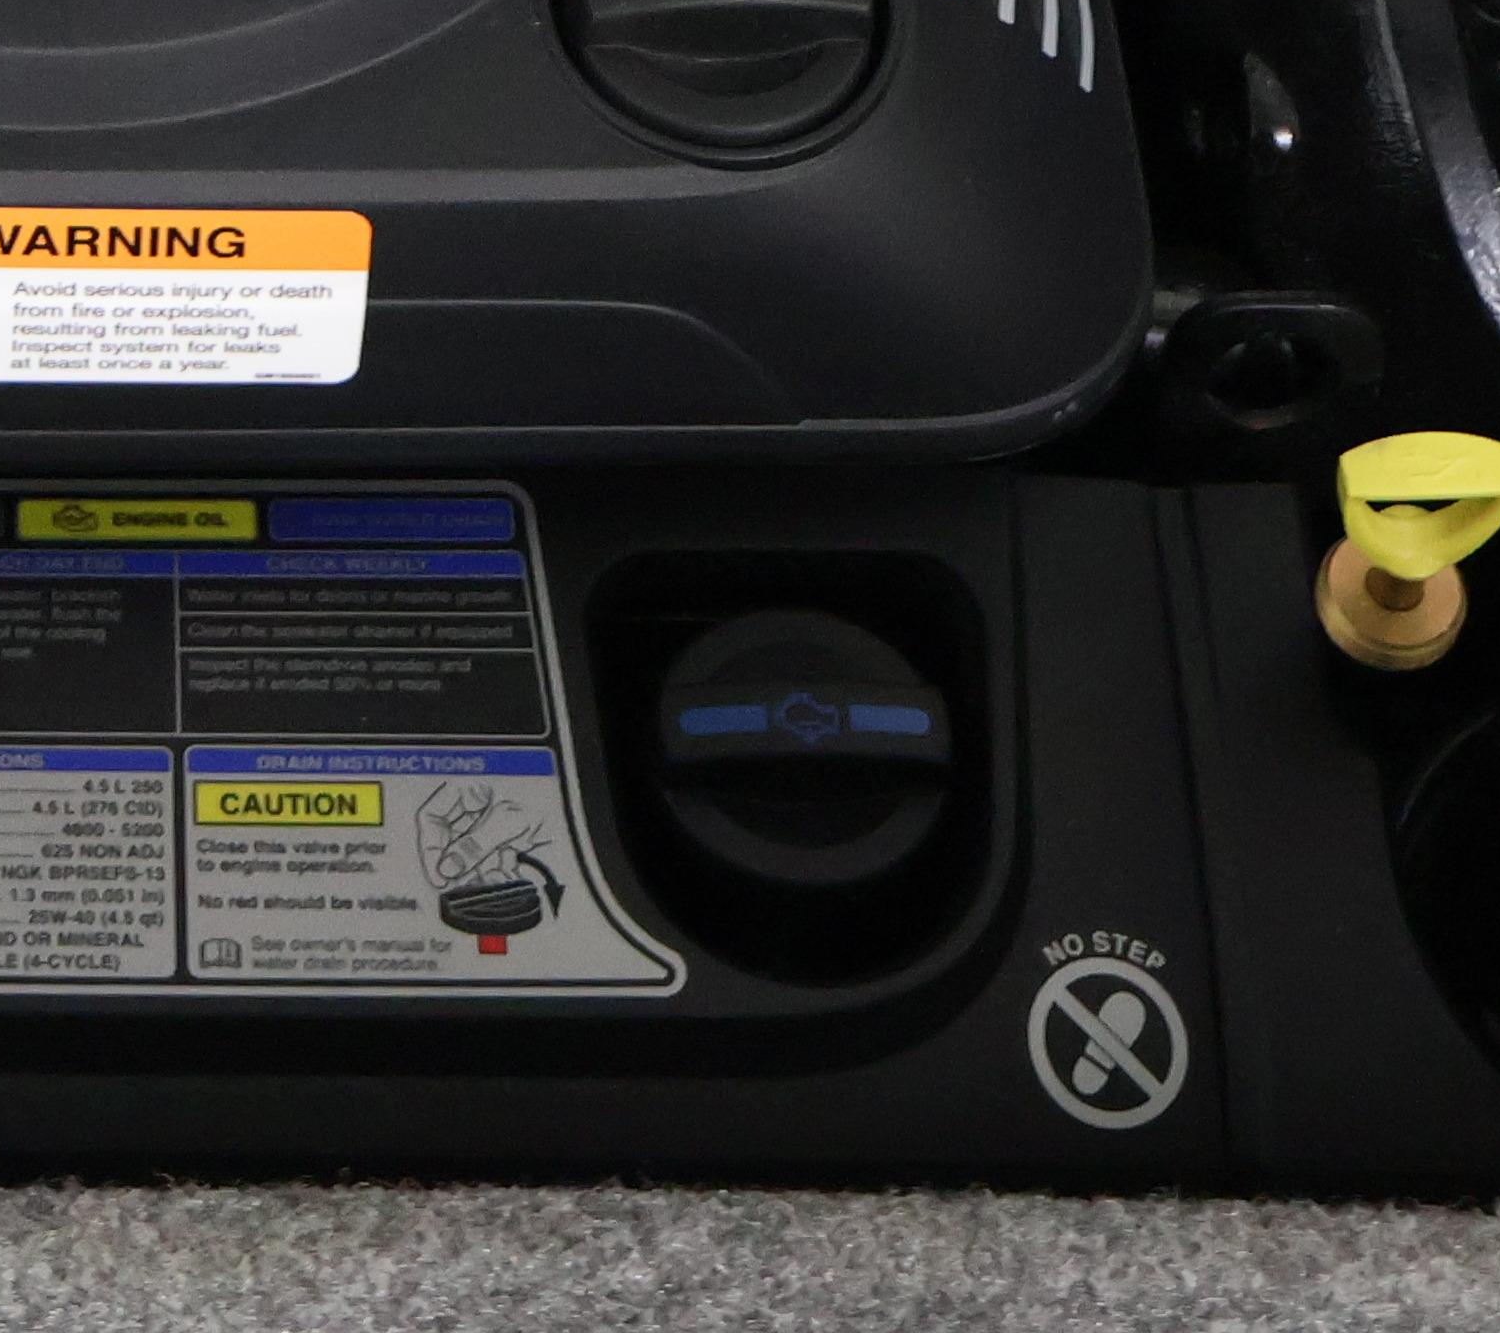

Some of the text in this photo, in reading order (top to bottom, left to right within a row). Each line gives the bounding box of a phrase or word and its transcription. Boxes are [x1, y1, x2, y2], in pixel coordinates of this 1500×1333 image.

[13, 282, 332, 301] Avoid serious injury or death
[13, 303, 63, 317] from
[71, 303, 105, 318] fire
[112, 307, 135, 318] or
[12, 324, 106, 338] resulting
[114, 323, 164, 336] from
[171, 324, 250, 339] leaking
[12, 338, 281, 356] Inspect system for leaks
[10, 358, 30, 369] at
[38, 358, 90, 369] least
[97, 360, 152, 370] once
[159, 360, 172, 370] a
[111, 511, 228, 527] ENGINE OIL
[256, 755, 485, 775] DRAIN INSTRUCTIONS
[219, 792, 357, 815] CAUTION
[79, 844, 122, 859] NON
[126, 844, 164, 859] ADJ
[195, 839, 387, 861] Close this valve prior
[0, 865, 42, 880] NGK
[196, 859, 215, 872] to
[220, 860, 282, 876] engine
[41, 891, 76, 903] mm
[197, 894, 223, 909] No
[228, 895, 258, 909] red
[264, 896, 326, 910] should
[331, 896, 353, 910] be
[139, 911, 165, 928] qt)
[23, 930, 51, 947] OR
[57, 932, 144, 947] MINERAL
[1042, 930, 1168, 969] NO STEP
[23, 954, 121, 971] (4-CYCLE)
